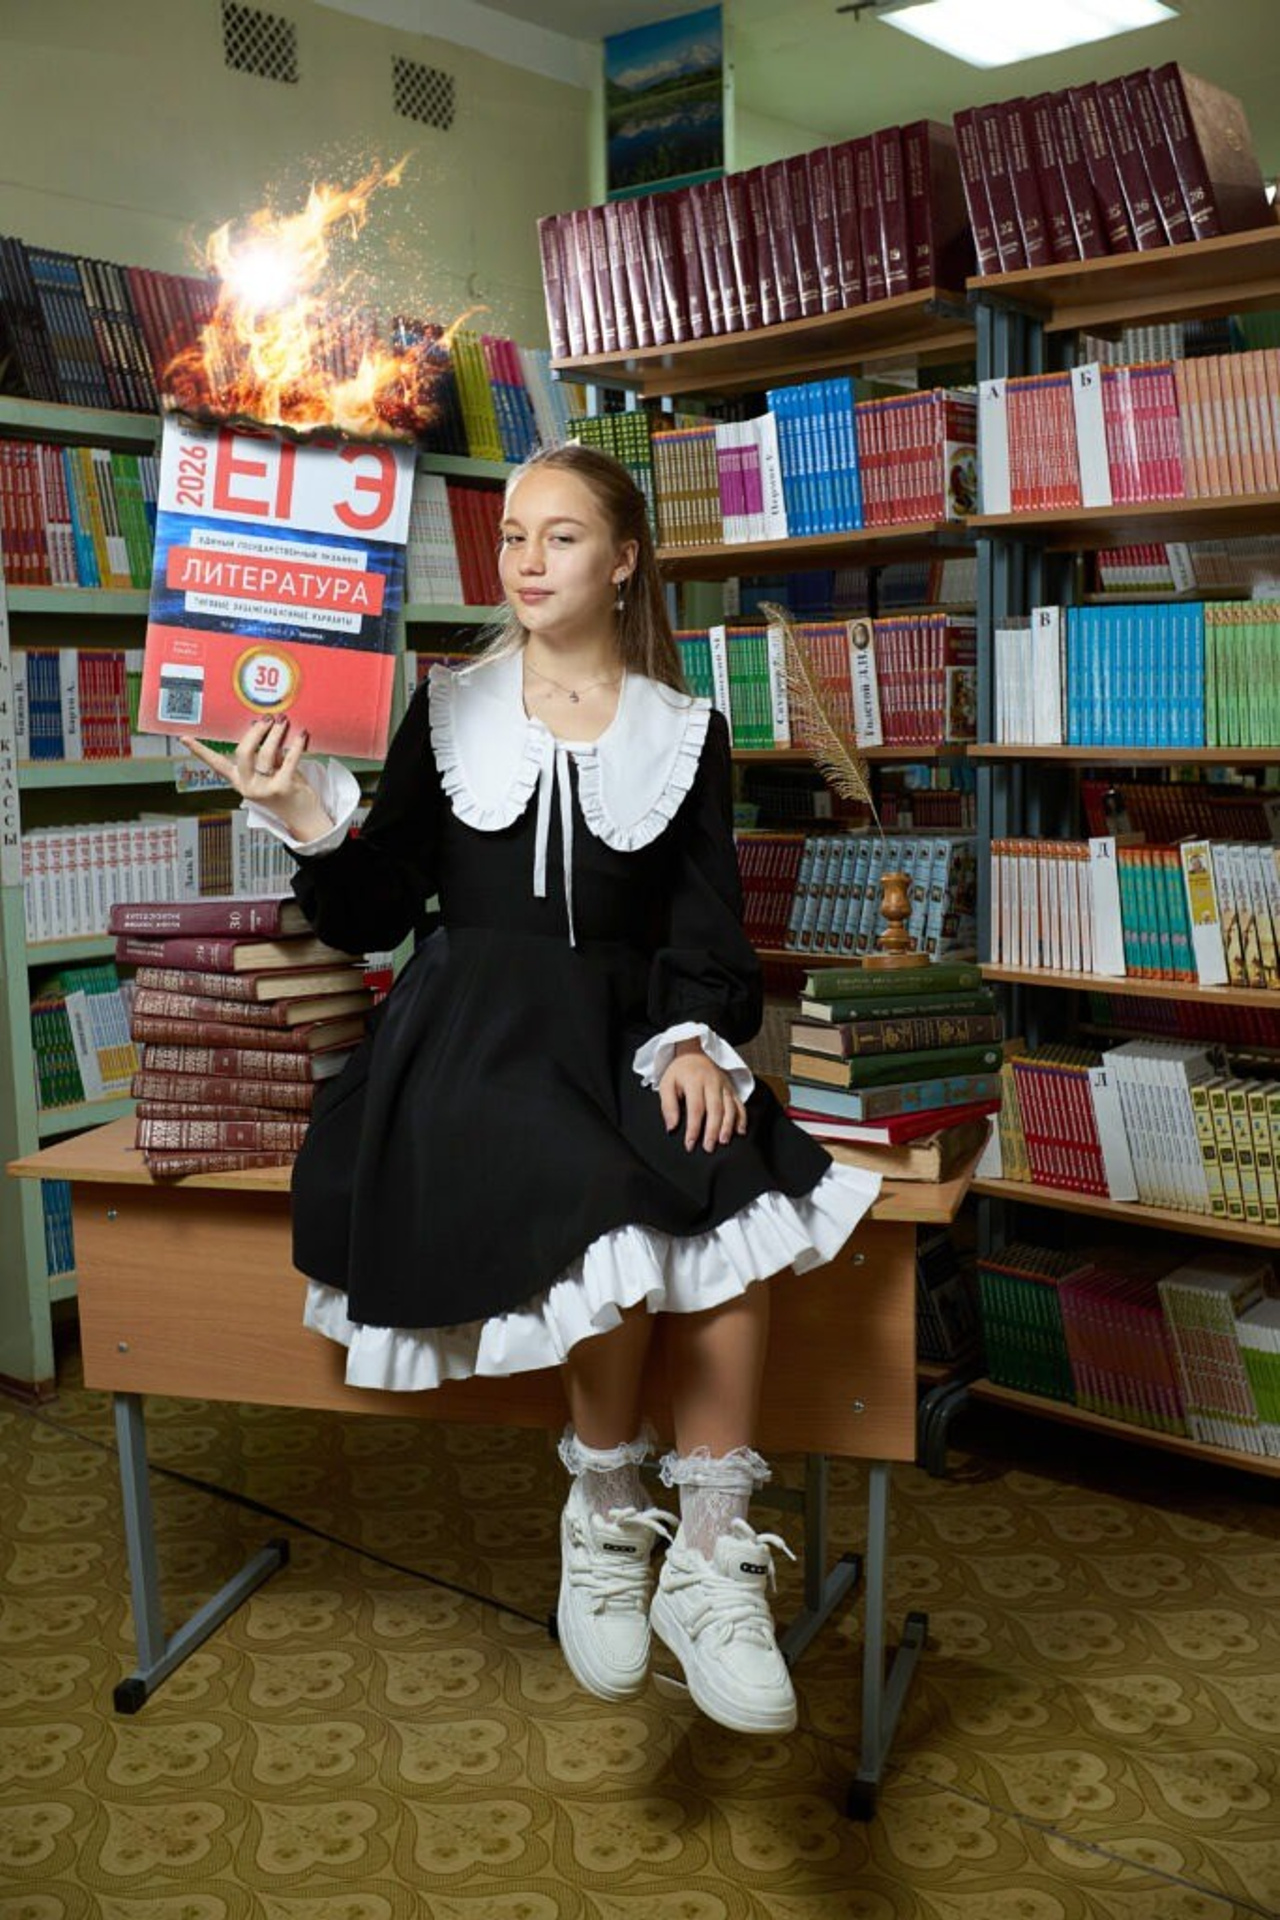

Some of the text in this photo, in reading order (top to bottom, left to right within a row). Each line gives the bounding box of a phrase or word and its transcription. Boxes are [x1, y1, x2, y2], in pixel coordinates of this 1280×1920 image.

[176, 445, 208, 507] 2026
[181, 557, 369, 606] ЛИТЕРАТУРА
[254, 664, 280, 687] 30
[1, 739, 17, 845] КЛАССЫ
[229, 911, 242, 929] 30
